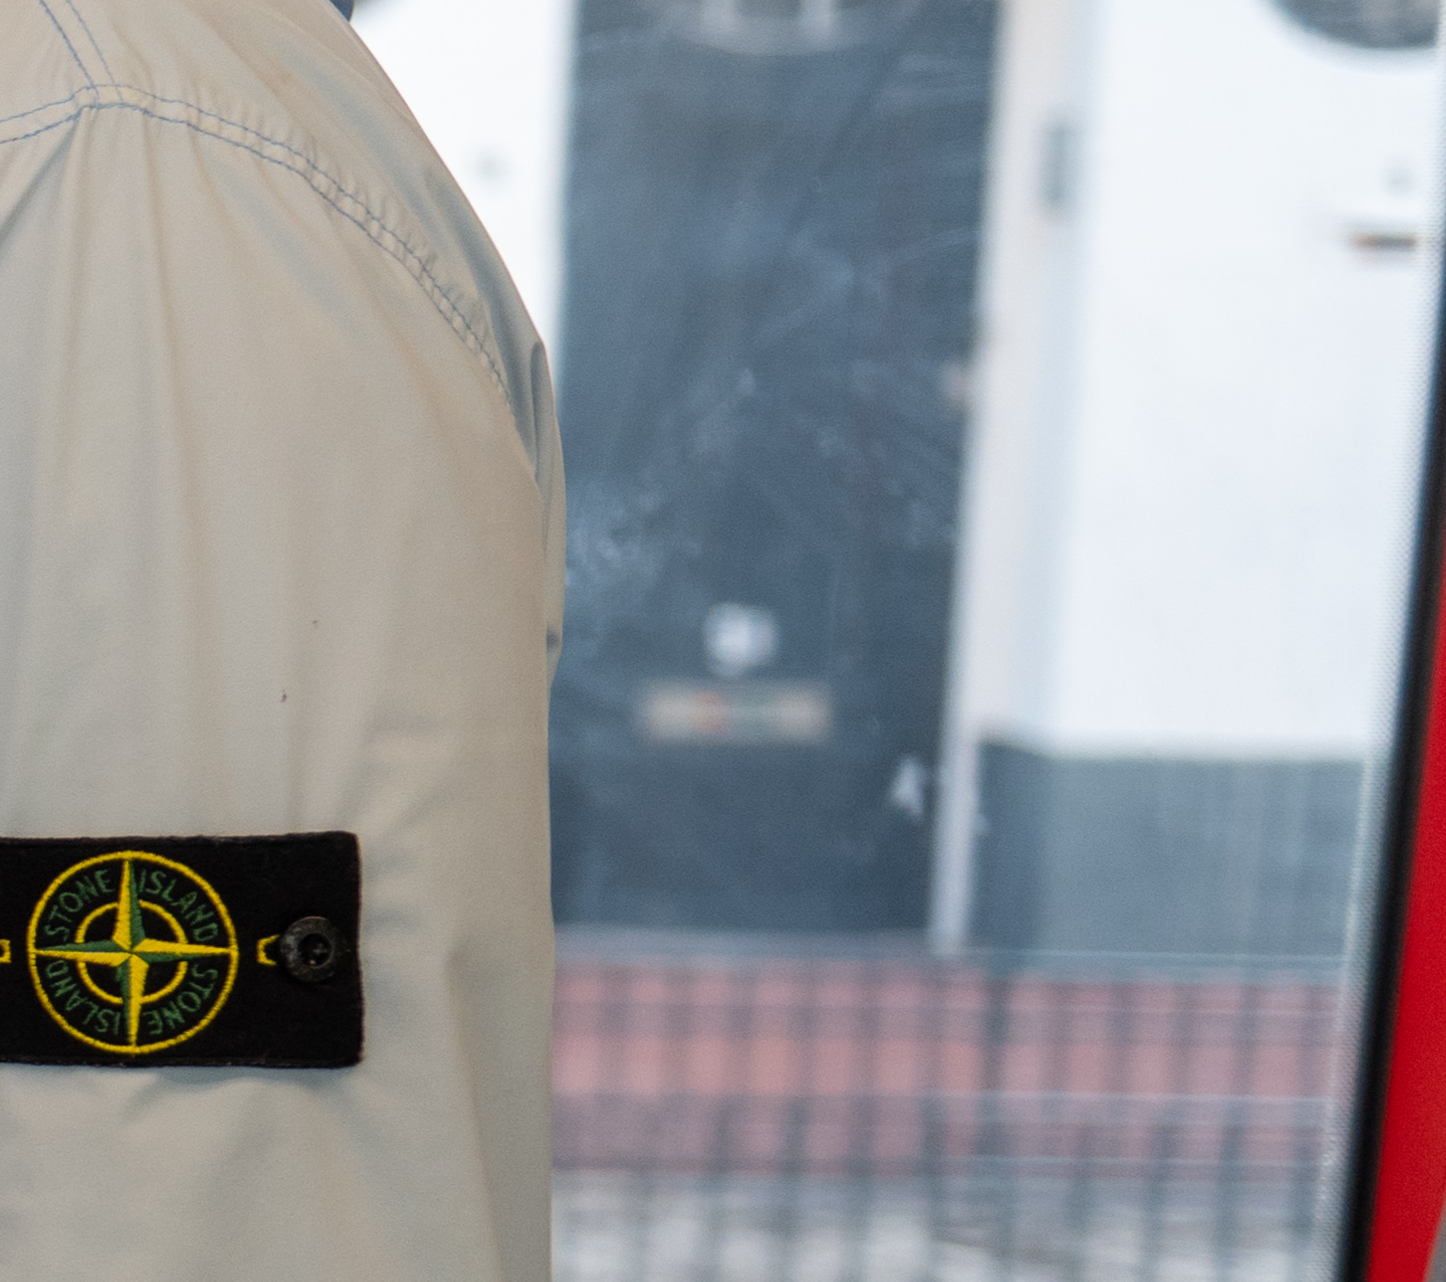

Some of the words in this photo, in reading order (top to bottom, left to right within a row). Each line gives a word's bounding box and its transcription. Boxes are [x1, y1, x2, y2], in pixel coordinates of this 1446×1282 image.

[44, 869, 116, 942] STONE
[138, 869, 219, 942] ISLAND
[45, 960, 122, 1036] ISLAND
[142, 963, 219, 1036] STONE
